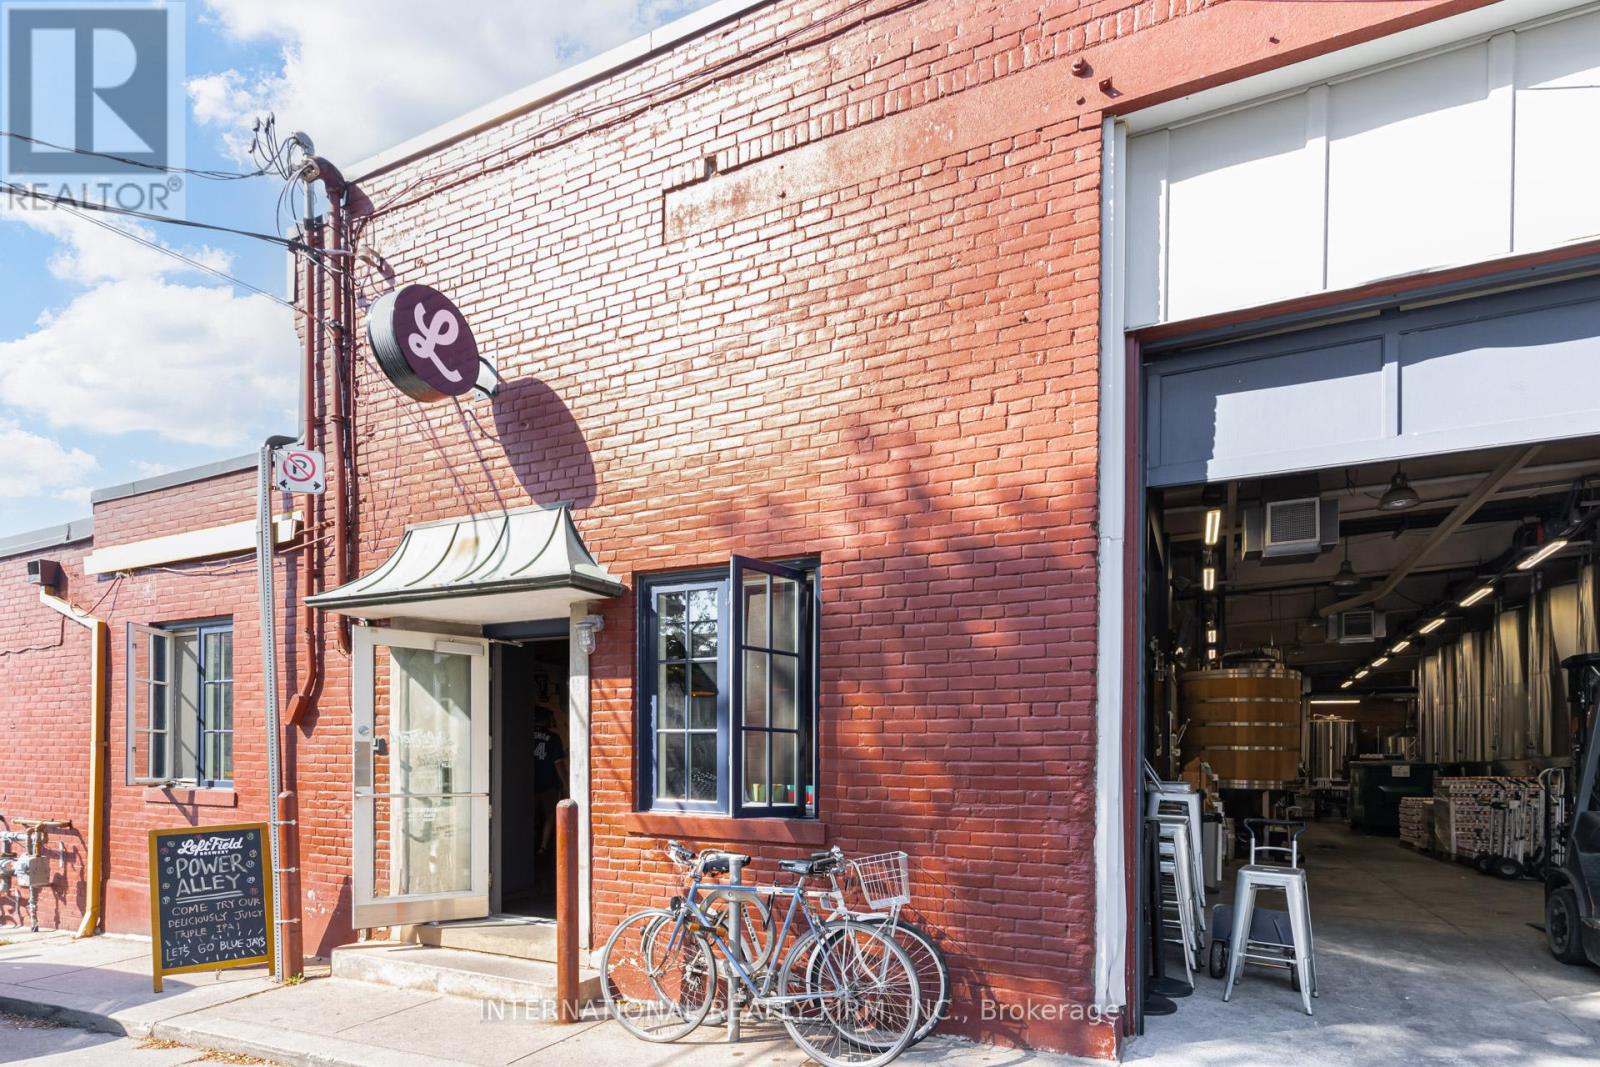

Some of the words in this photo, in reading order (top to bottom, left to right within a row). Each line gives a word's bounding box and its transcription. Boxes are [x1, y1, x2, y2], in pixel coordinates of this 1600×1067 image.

[177, 839, 210, 856] Left
[209, 836, 244, 851] Field
[176, 853, 248, 879] POWER
[176, 873, 240, 897] ALLEY
[172, 903, 208, 916] COME
[216, 900, 235, 911] TRY
[238, 897, 261, 907] OUR
[168, 911, 228, 928] DELICIOUSLY
[234, 910, 263, 920] JUICY
[174, 927, 208, 940] TRIPLE
[197, 942, 215, 954] GO
[220, 938, 244, 951] BLUE
[246, 936, 266, 948] JAYS
